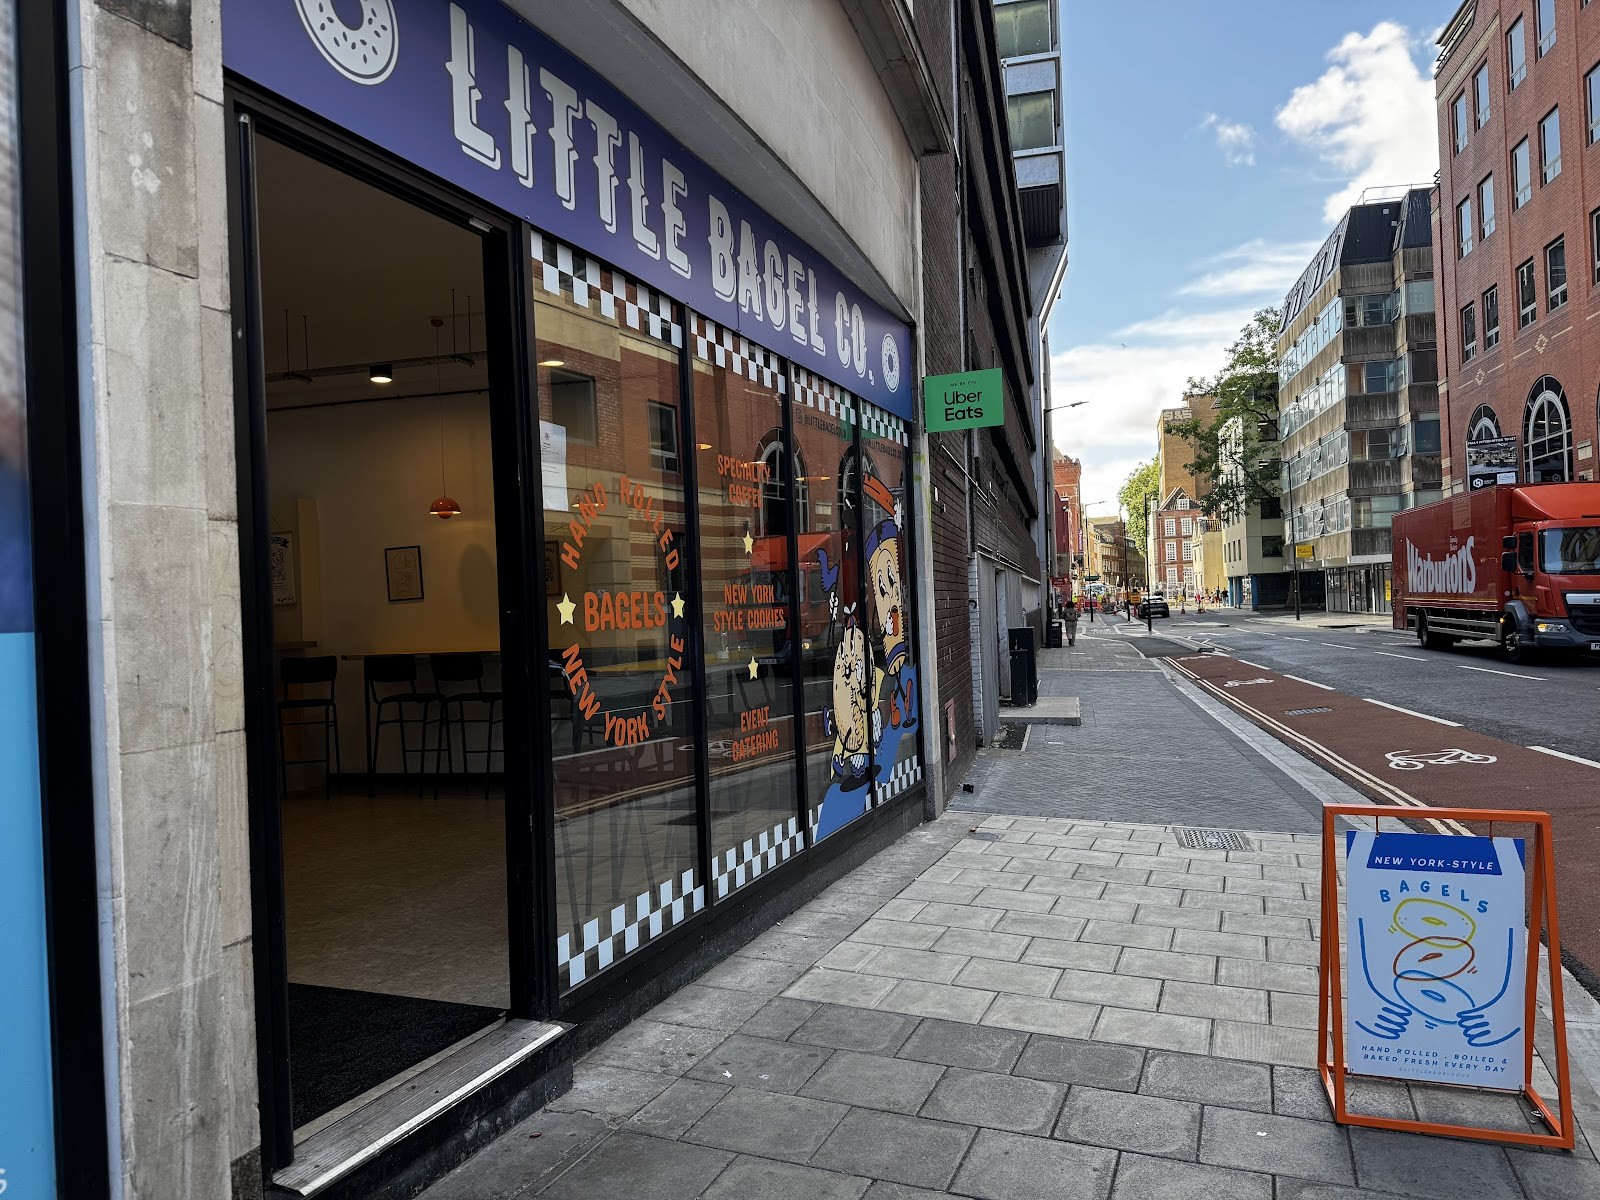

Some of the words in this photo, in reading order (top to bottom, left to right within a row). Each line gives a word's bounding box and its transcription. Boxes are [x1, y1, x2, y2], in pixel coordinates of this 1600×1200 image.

[445, 2, 692, 280] LITTLE
[706, 194, 827, 357] BAGEL
[943, 390, 983, 406] Uber
[944, 405, 984, 422] Eats
[728, 483, 763, 509] COFFEE
[560, 481, 609, 571] HAND
[619, 474, 680, 571] ROLLED
[1405, 535, 1477, 595] Warburtons
[724, 583, 748, 606] NEW
[751, 583, 775, 604] YORK
[583, 590, 667, 632] BAGELS
[713, 609, 744, 632] STYLE
[747, 608, 785, 630] COOKIES
[561, 643, 601, 721] NEW
[603, 710, 650, 747] YORK
[652, 633, 685, 721] STYLE
[740, 705, 770, 734] EVENT
[732, 728, 779, 762] CATERING
[1374, 856, 1404, 866] NEW
[1409, 858, 1495, 871] YORK-STYLE
[1379, 879, 1489, 914] BAGELS
[1361, 1045, 1390, 1053] HAND
[1397, 1048, 1438, 1058] ROLLED
[1454, 1054, 1495, 1063] BOILED
[1363, 1053, 1398, 1062] BAKED
[1404, 1057, 1438, 1066] FRESH
[1444, 1061, 1479, 1070] EVERY
